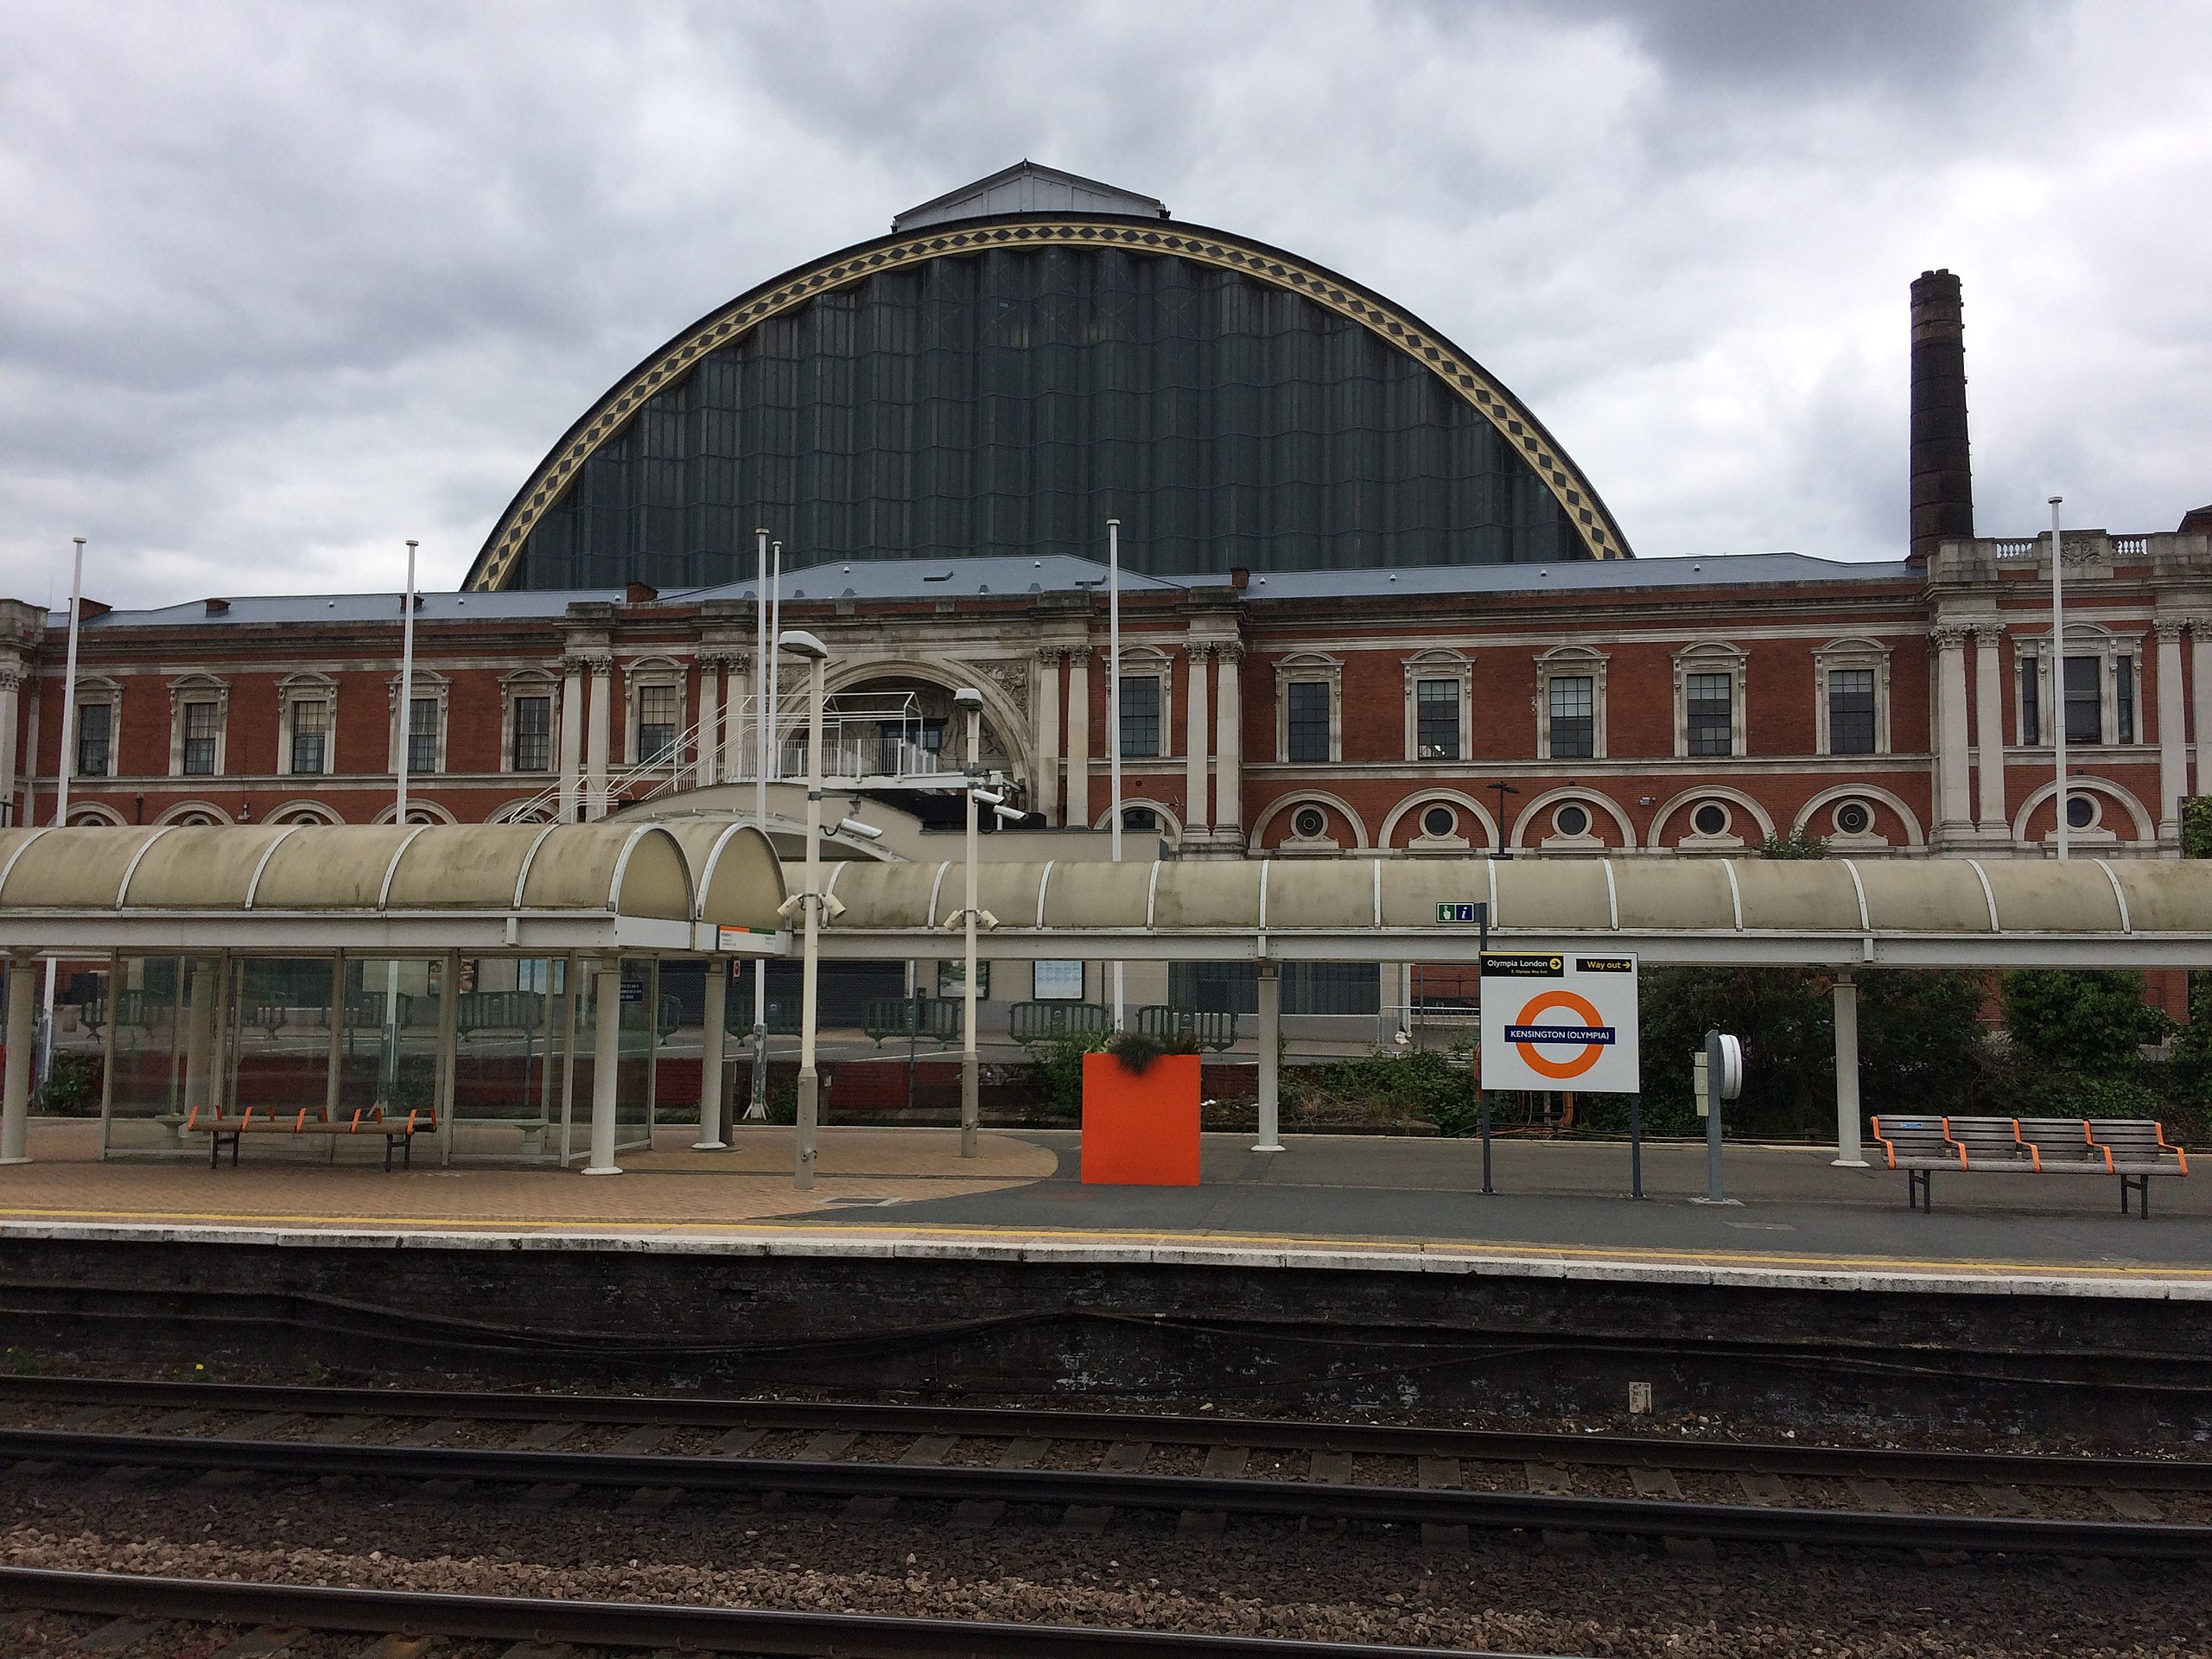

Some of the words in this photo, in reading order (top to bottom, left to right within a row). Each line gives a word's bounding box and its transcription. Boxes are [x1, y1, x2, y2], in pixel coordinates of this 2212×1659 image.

[1461, 906, 1468, 919] i
[1487, 959, 1518, 969] Olympia
[1586, 961, 1605, 969] Way
[1510, 1030, 1566, 1039] KENSINGTON
[1567, 1031, 1609, 1039] (OLYMPIA)
